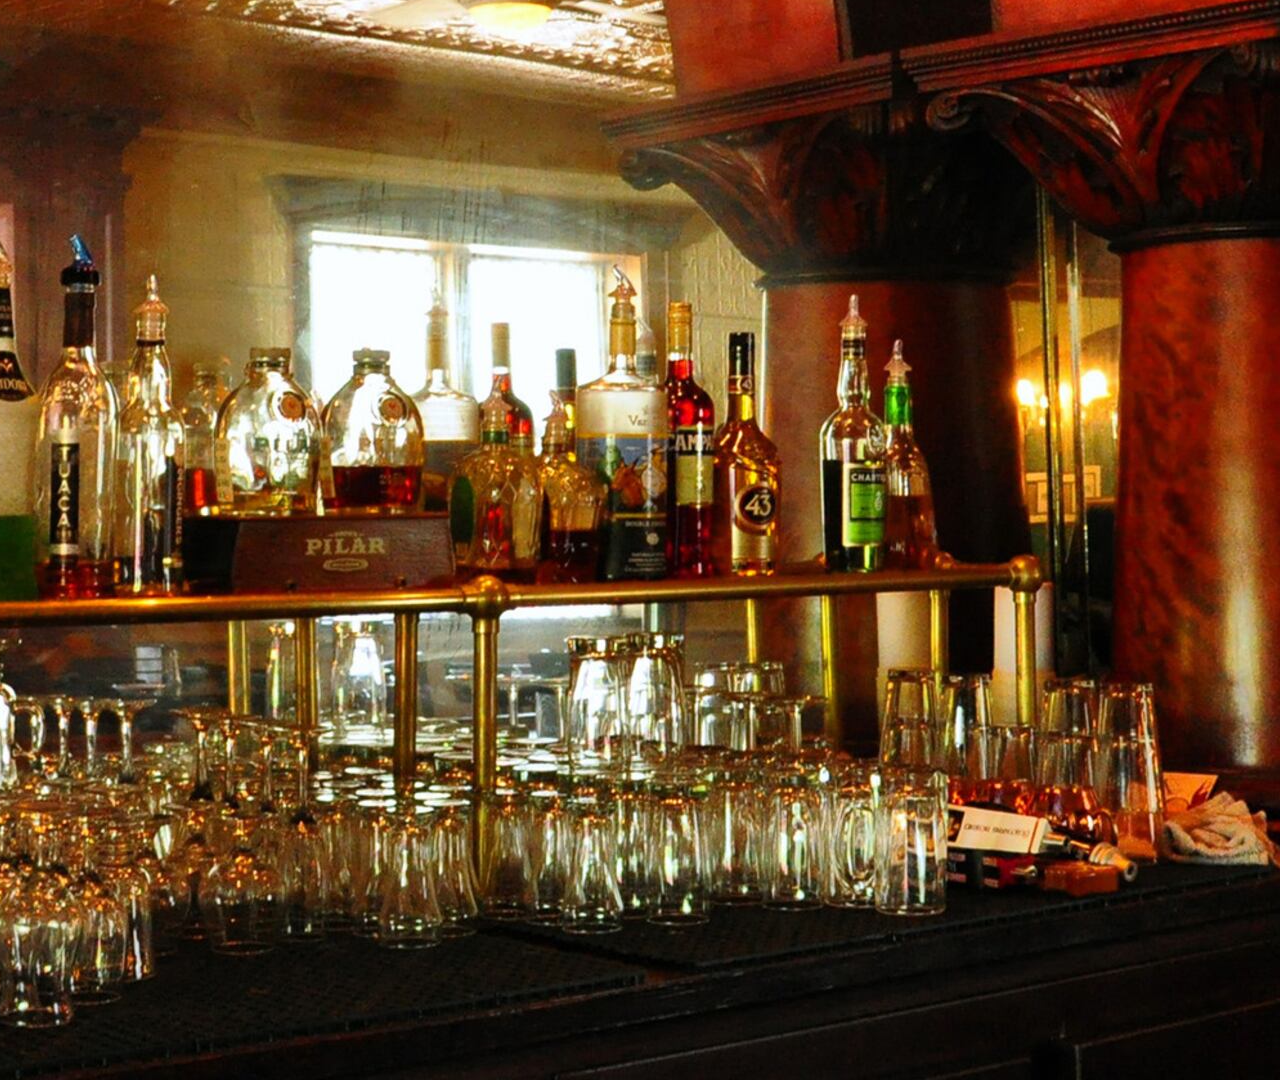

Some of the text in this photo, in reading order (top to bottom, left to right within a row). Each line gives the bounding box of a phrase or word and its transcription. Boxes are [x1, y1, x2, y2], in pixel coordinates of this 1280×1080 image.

[57, 446, 71, 528] TUACA
[744, 493, 772, 517] 43
[305, 536, 387, 556] PILAR
